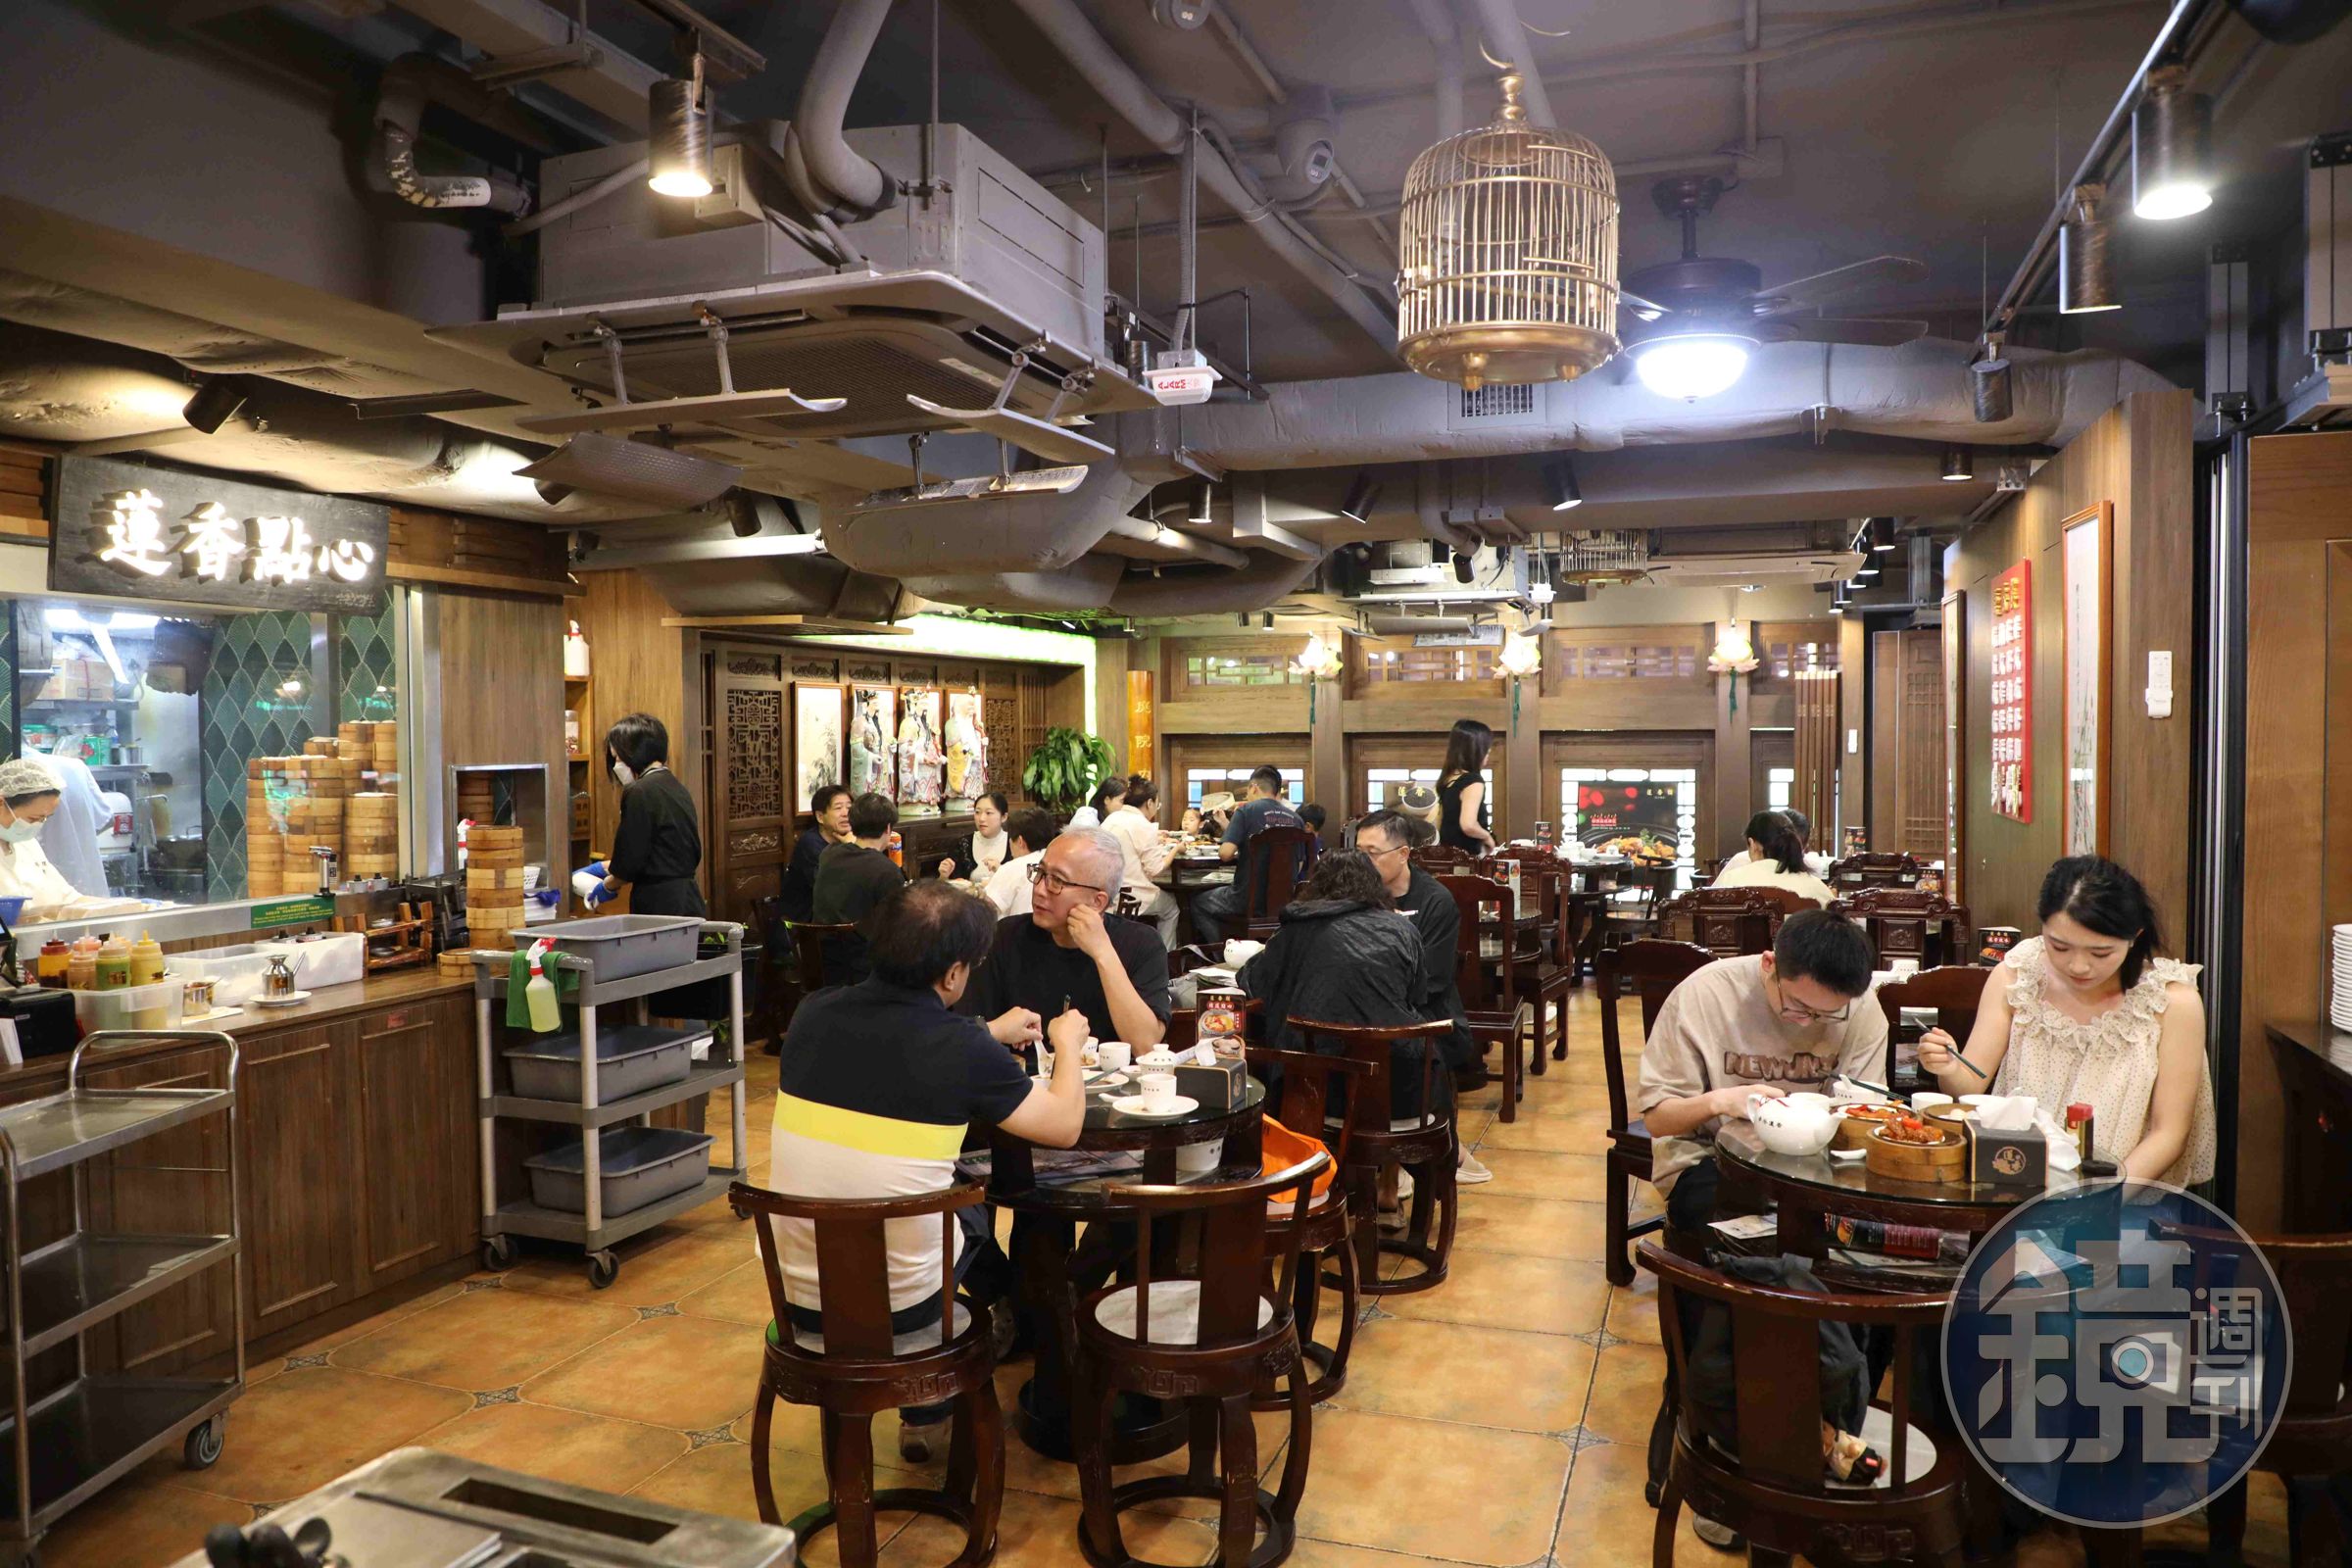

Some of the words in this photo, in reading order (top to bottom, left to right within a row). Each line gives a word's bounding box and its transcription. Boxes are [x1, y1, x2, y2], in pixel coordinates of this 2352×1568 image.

[1157, 379, 1187, 390] ALARM
[99, 488, 374, 584] 蓮香點心
